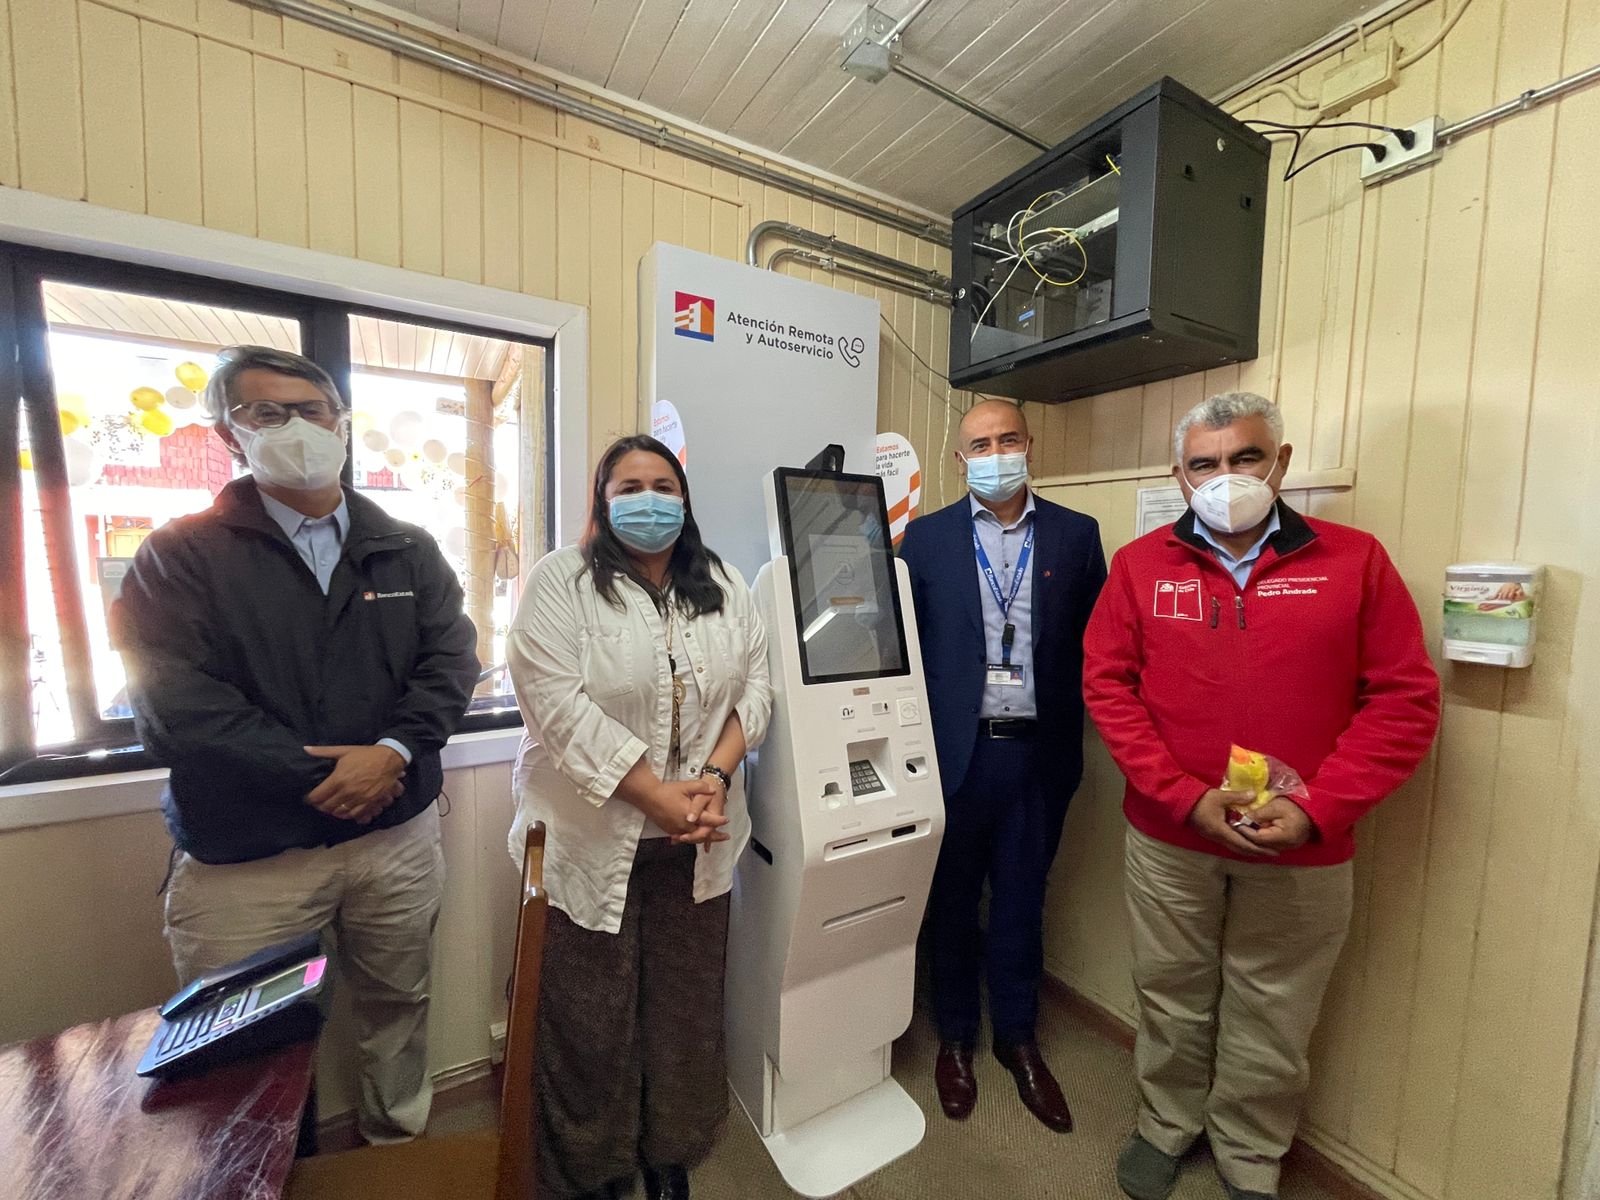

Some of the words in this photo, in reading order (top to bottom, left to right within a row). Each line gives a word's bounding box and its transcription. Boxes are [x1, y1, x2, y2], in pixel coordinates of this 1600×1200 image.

[727, 311, 785, 334] Atención
[788, 325, 834, 346] Remota
[745, 333, 753, 344] y
[758, 333, 834, 359] Autoservicio
[876, 444, 899, 453] Estamos
[888, 450, 910, 459] hacerte
[1450, 585, 1490, 595] Virginia
